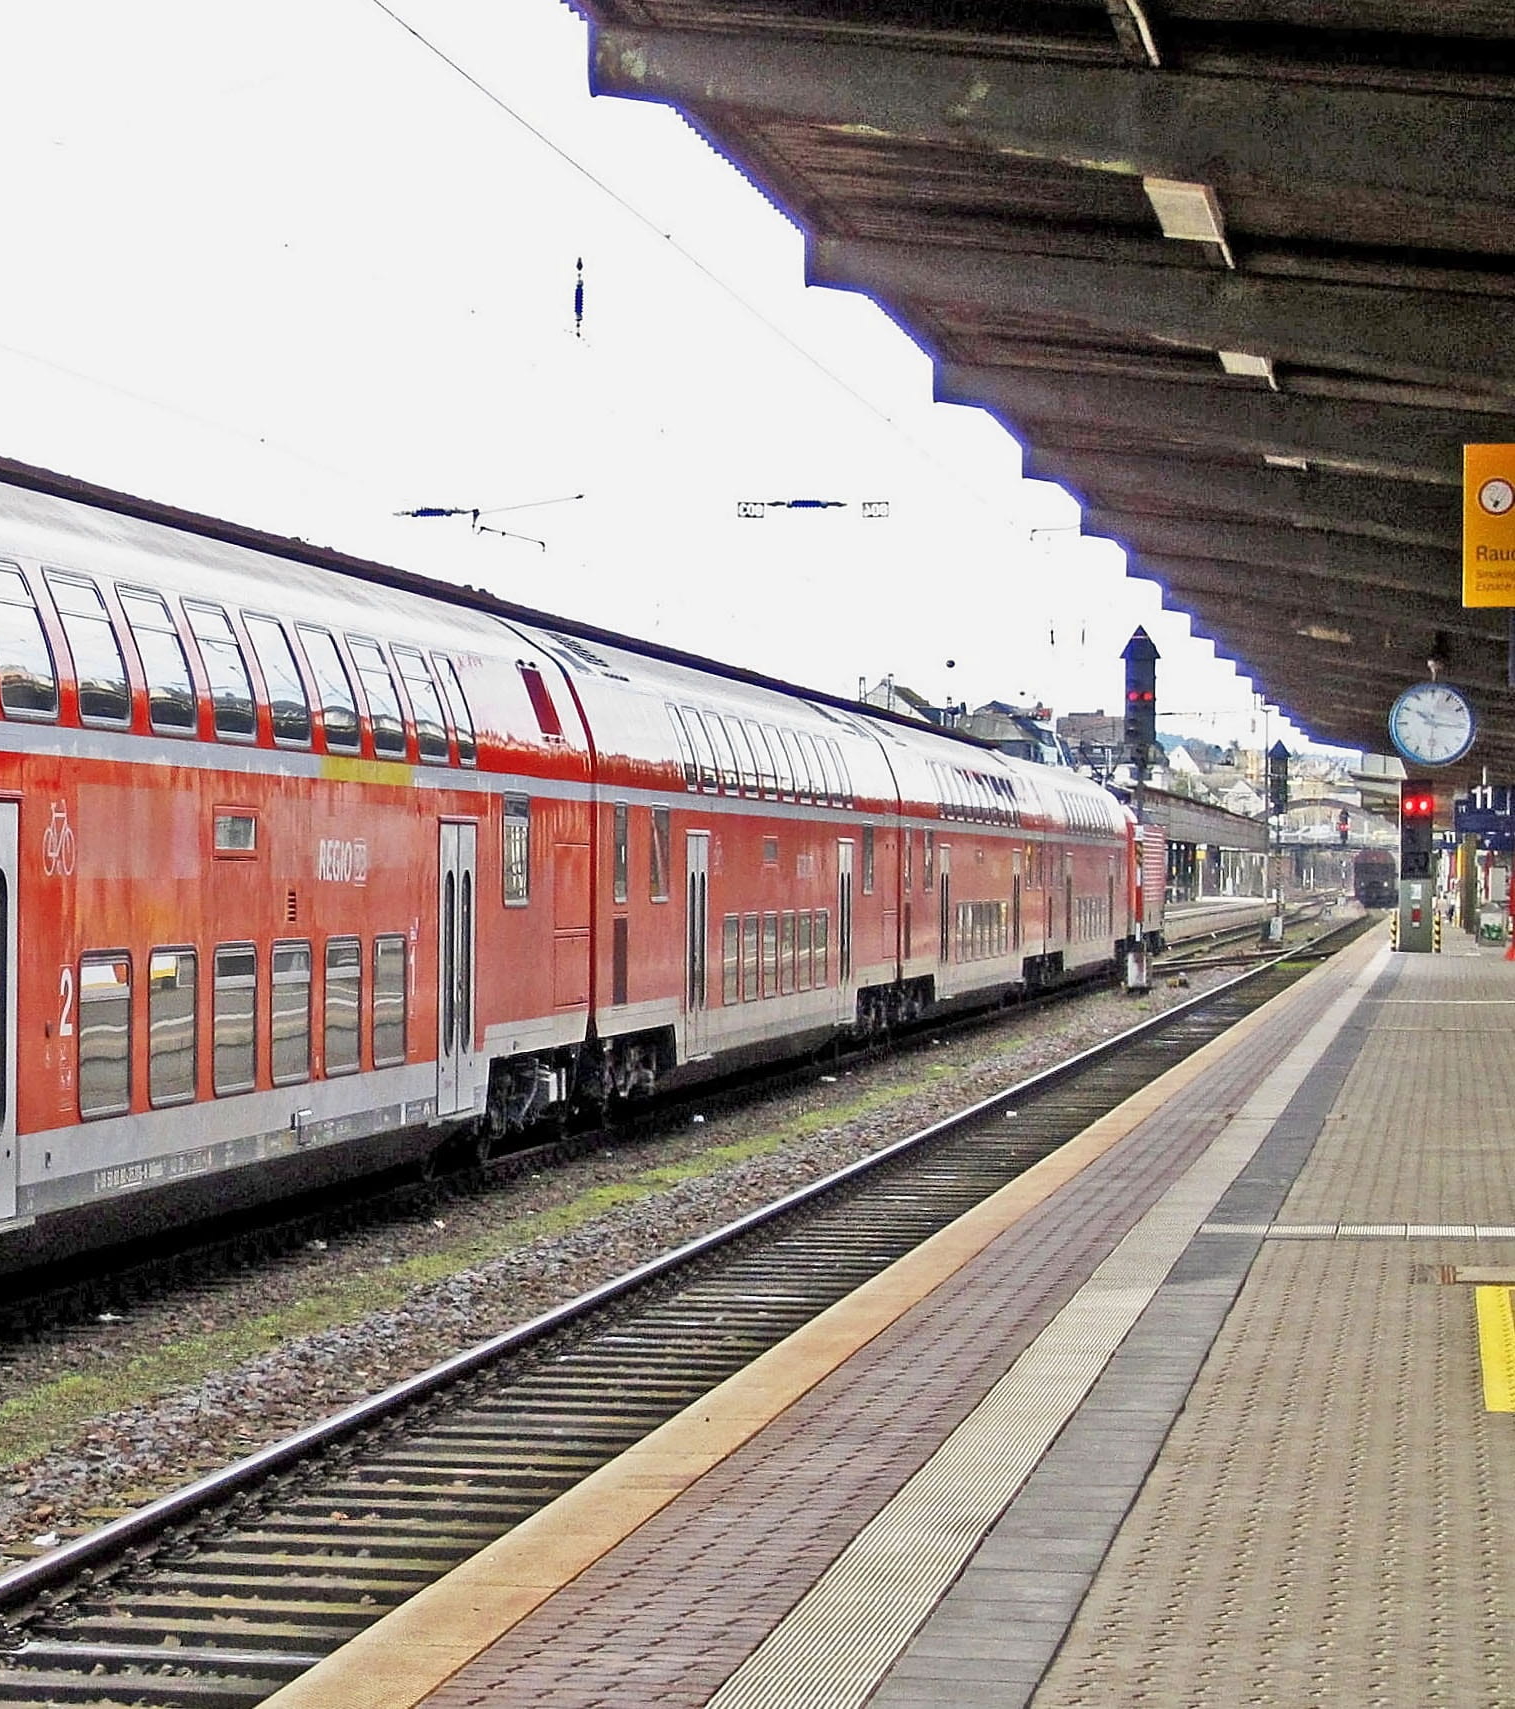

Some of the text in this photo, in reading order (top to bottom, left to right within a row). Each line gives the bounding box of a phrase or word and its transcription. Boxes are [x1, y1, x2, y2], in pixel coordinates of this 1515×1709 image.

[1471, 785, 1493, 809] 11
[1444, 831, 1456, 843] 11
[318, 839, 353, 882] REGIO
[59, 967, 73, 1036] 2
